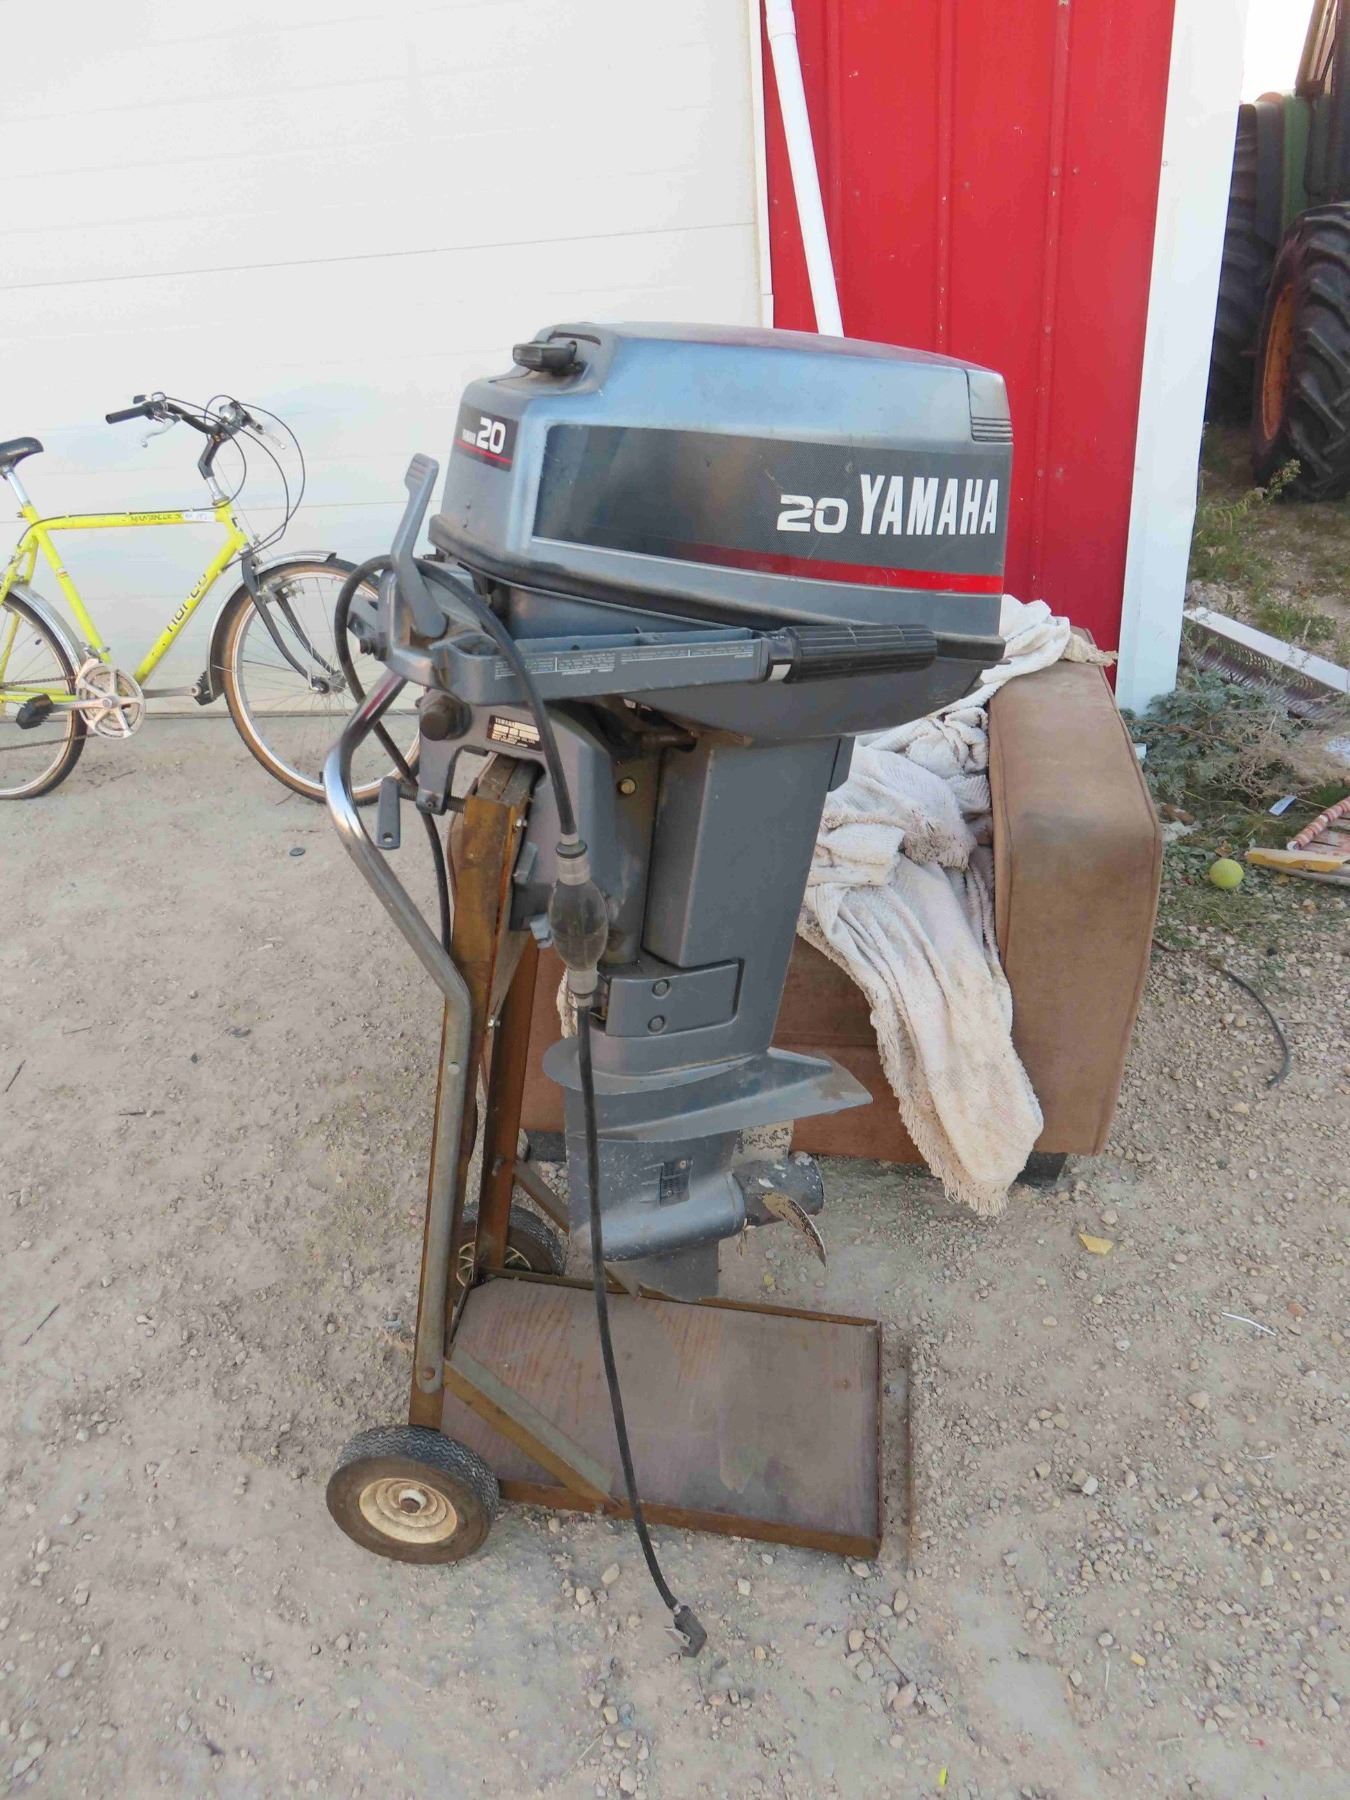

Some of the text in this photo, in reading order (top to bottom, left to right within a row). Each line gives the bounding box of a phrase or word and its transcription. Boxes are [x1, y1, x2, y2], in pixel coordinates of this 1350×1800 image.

[476, 416, 507, 455] 20
[776, 473, 999, 536] 20 YAMAHA
